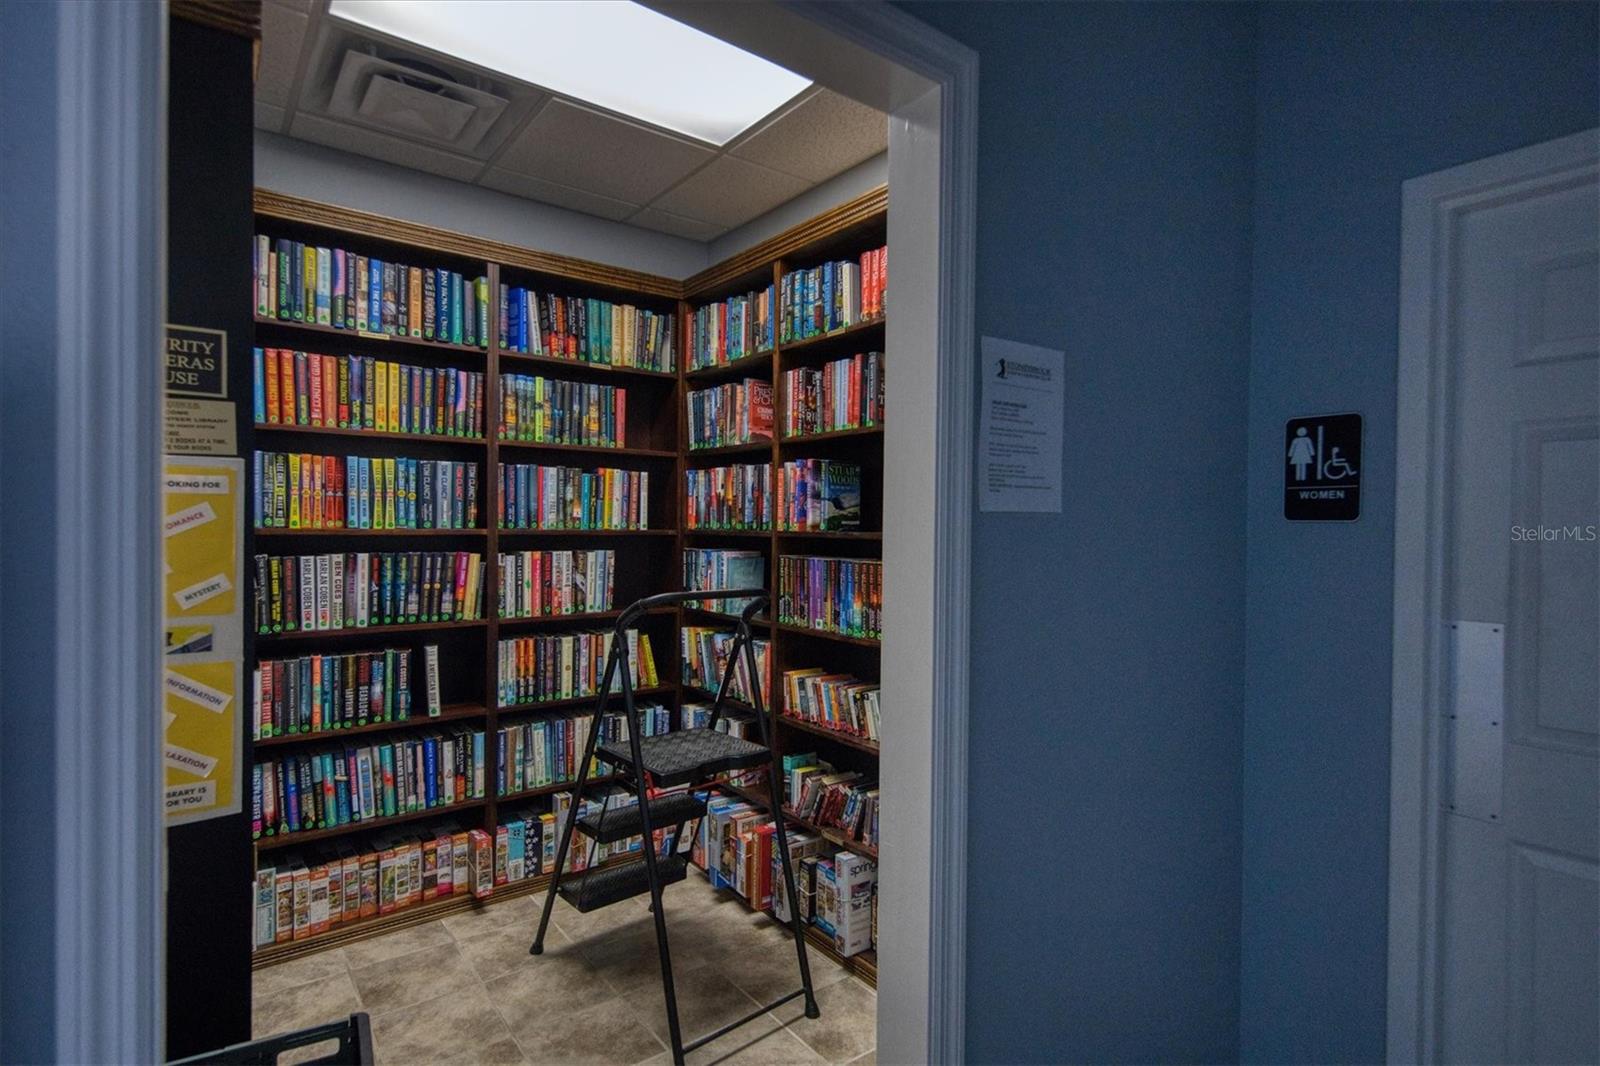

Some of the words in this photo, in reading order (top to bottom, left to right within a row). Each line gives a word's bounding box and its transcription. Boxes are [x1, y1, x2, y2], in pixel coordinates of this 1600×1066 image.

[170, 338, 215, 355] RITY
[165, 354, 215, 372] ERAS
[1300, 490, 1345, 500] WOMEN
[166, 512, 205, 530] OMANCE
[303, 558, 312, 586] HARLAN
[320, 559, 328, 585] HARLAN
[184, 582, 221, 602] MYSTERY
[303, 587, 312, 610] COBEN
[320, 586, 328, 608] COBEN
[166, 678, 222, 706] INFORMATION
[359, 686, 368, 718] DEADLOCK
